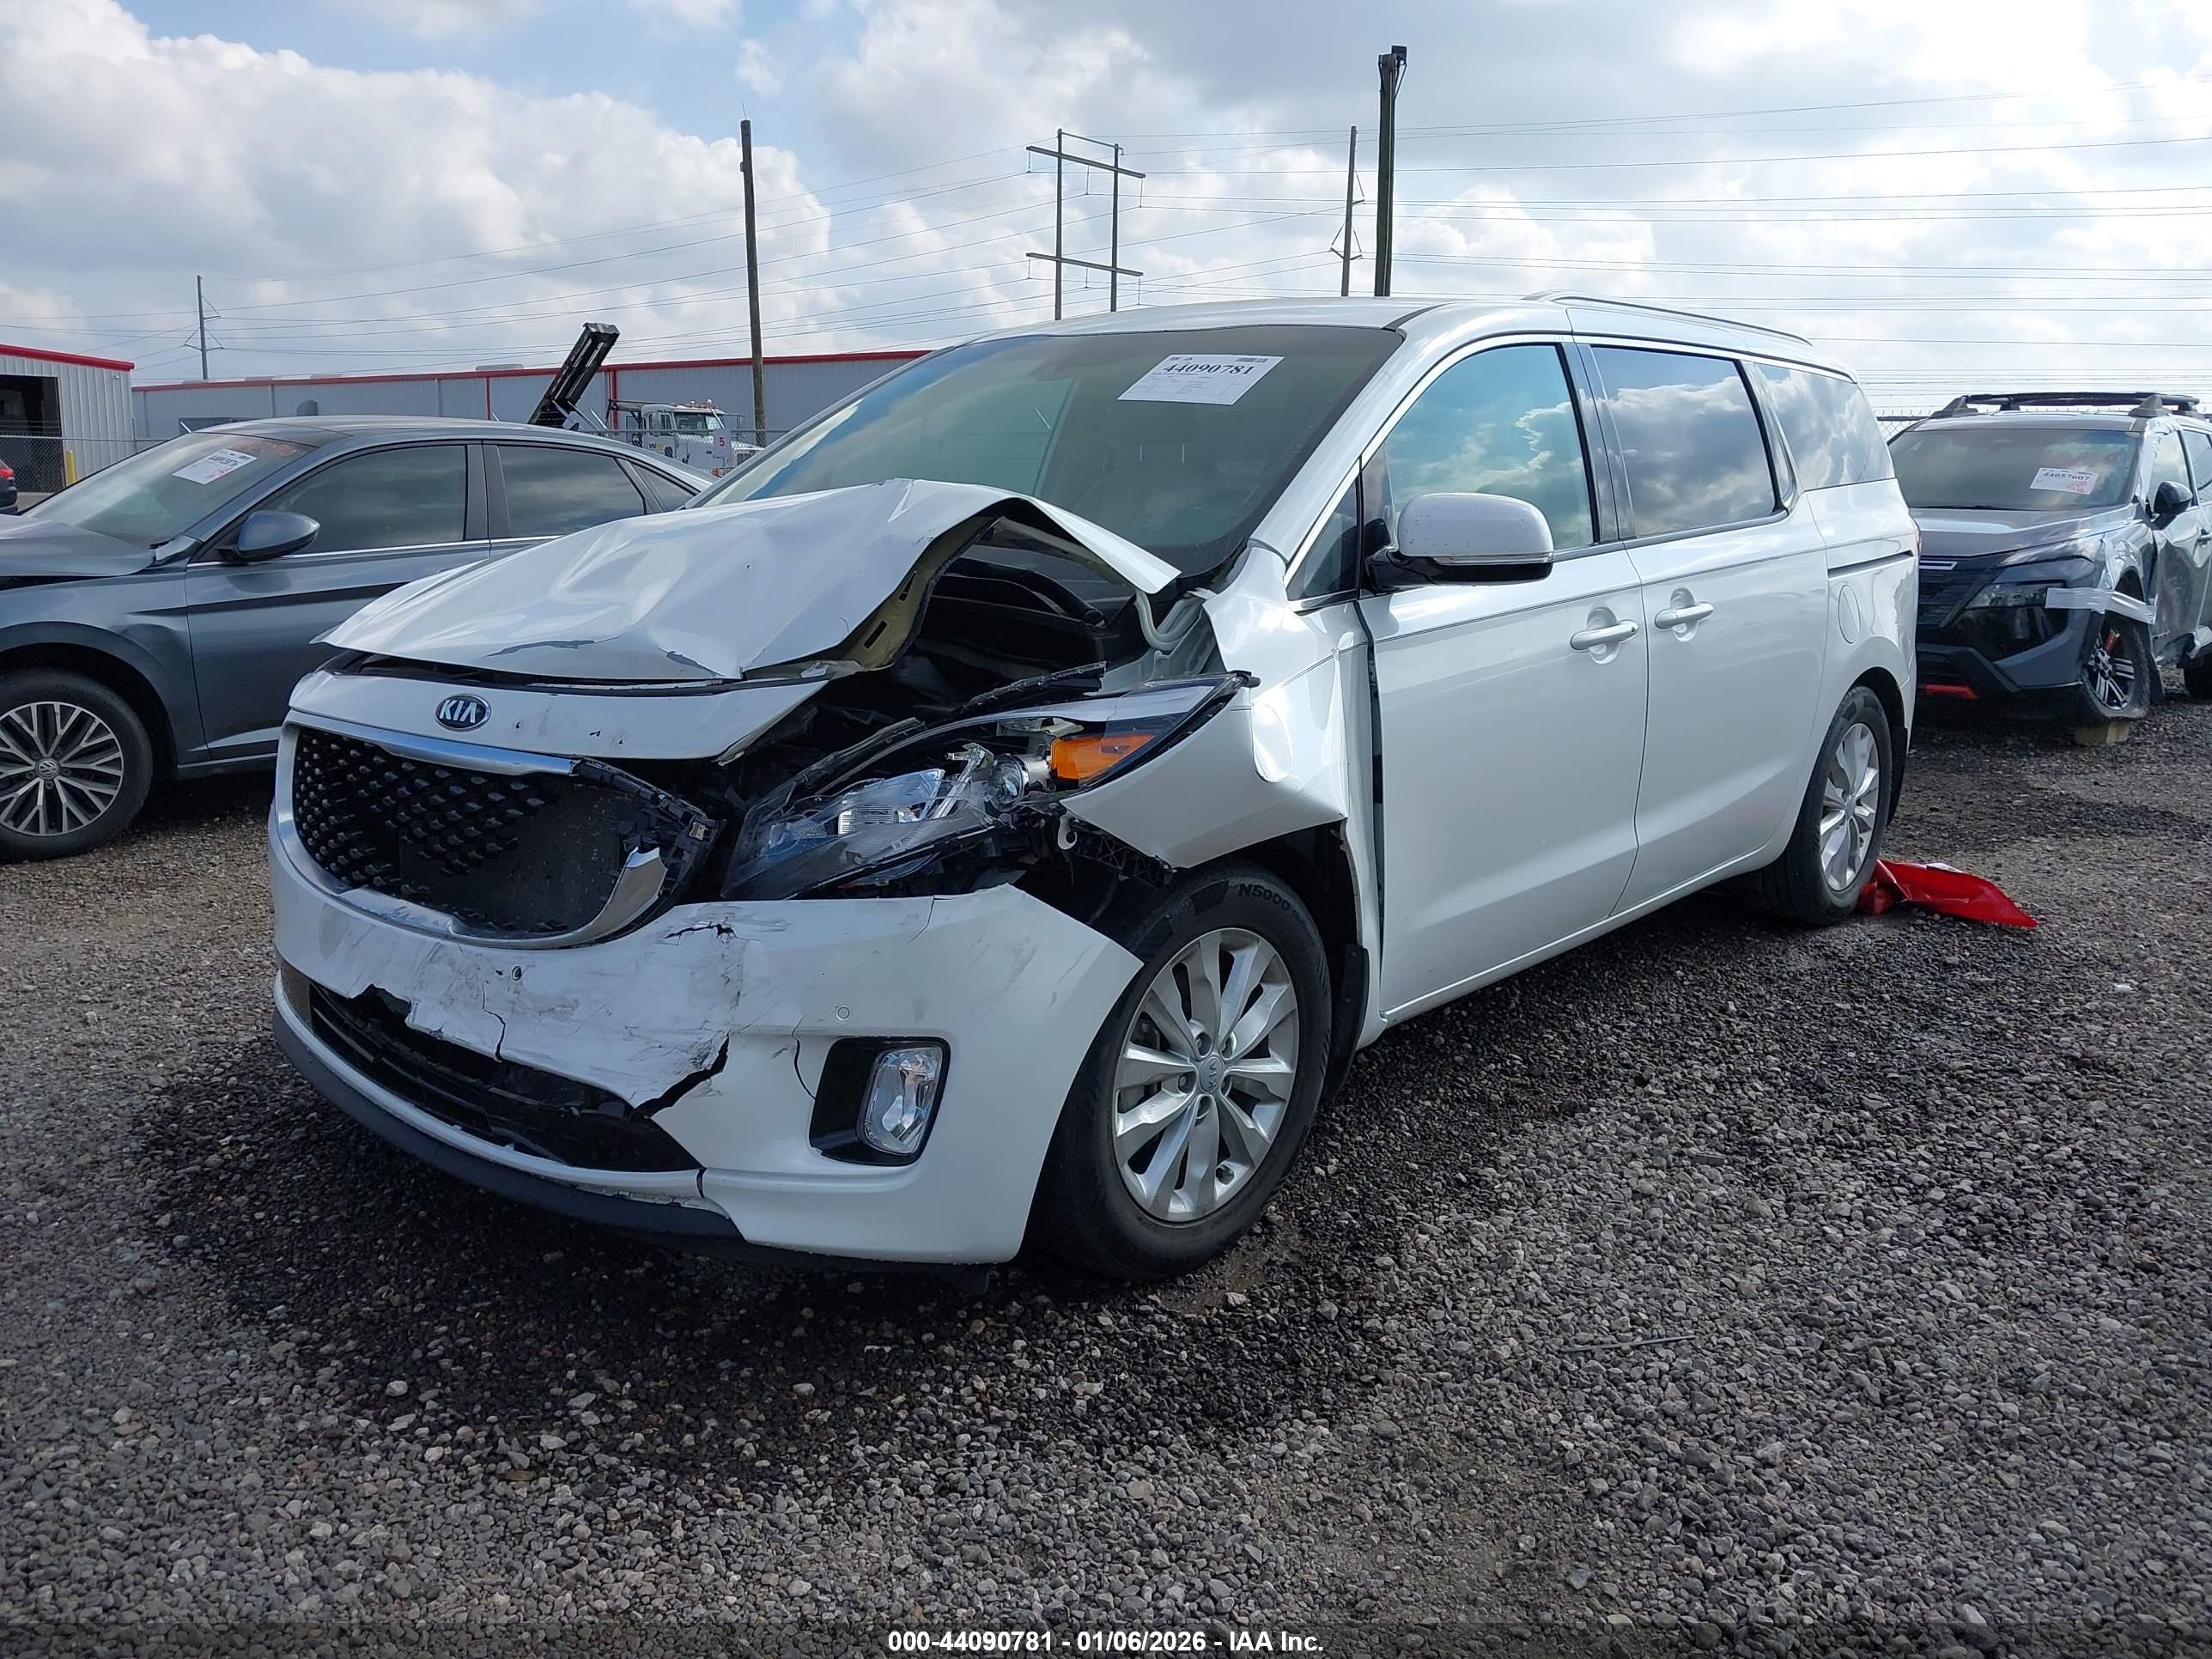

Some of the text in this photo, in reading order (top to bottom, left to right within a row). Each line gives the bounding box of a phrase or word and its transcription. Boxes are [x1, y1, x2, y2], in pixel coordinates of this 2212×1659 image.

[1164, 363, 1255, 374] 44090781
[719, 436, 726, 447] 5
[439, 699, 477, 724] KIA
[1237, 883, 1291, 911] N5000
